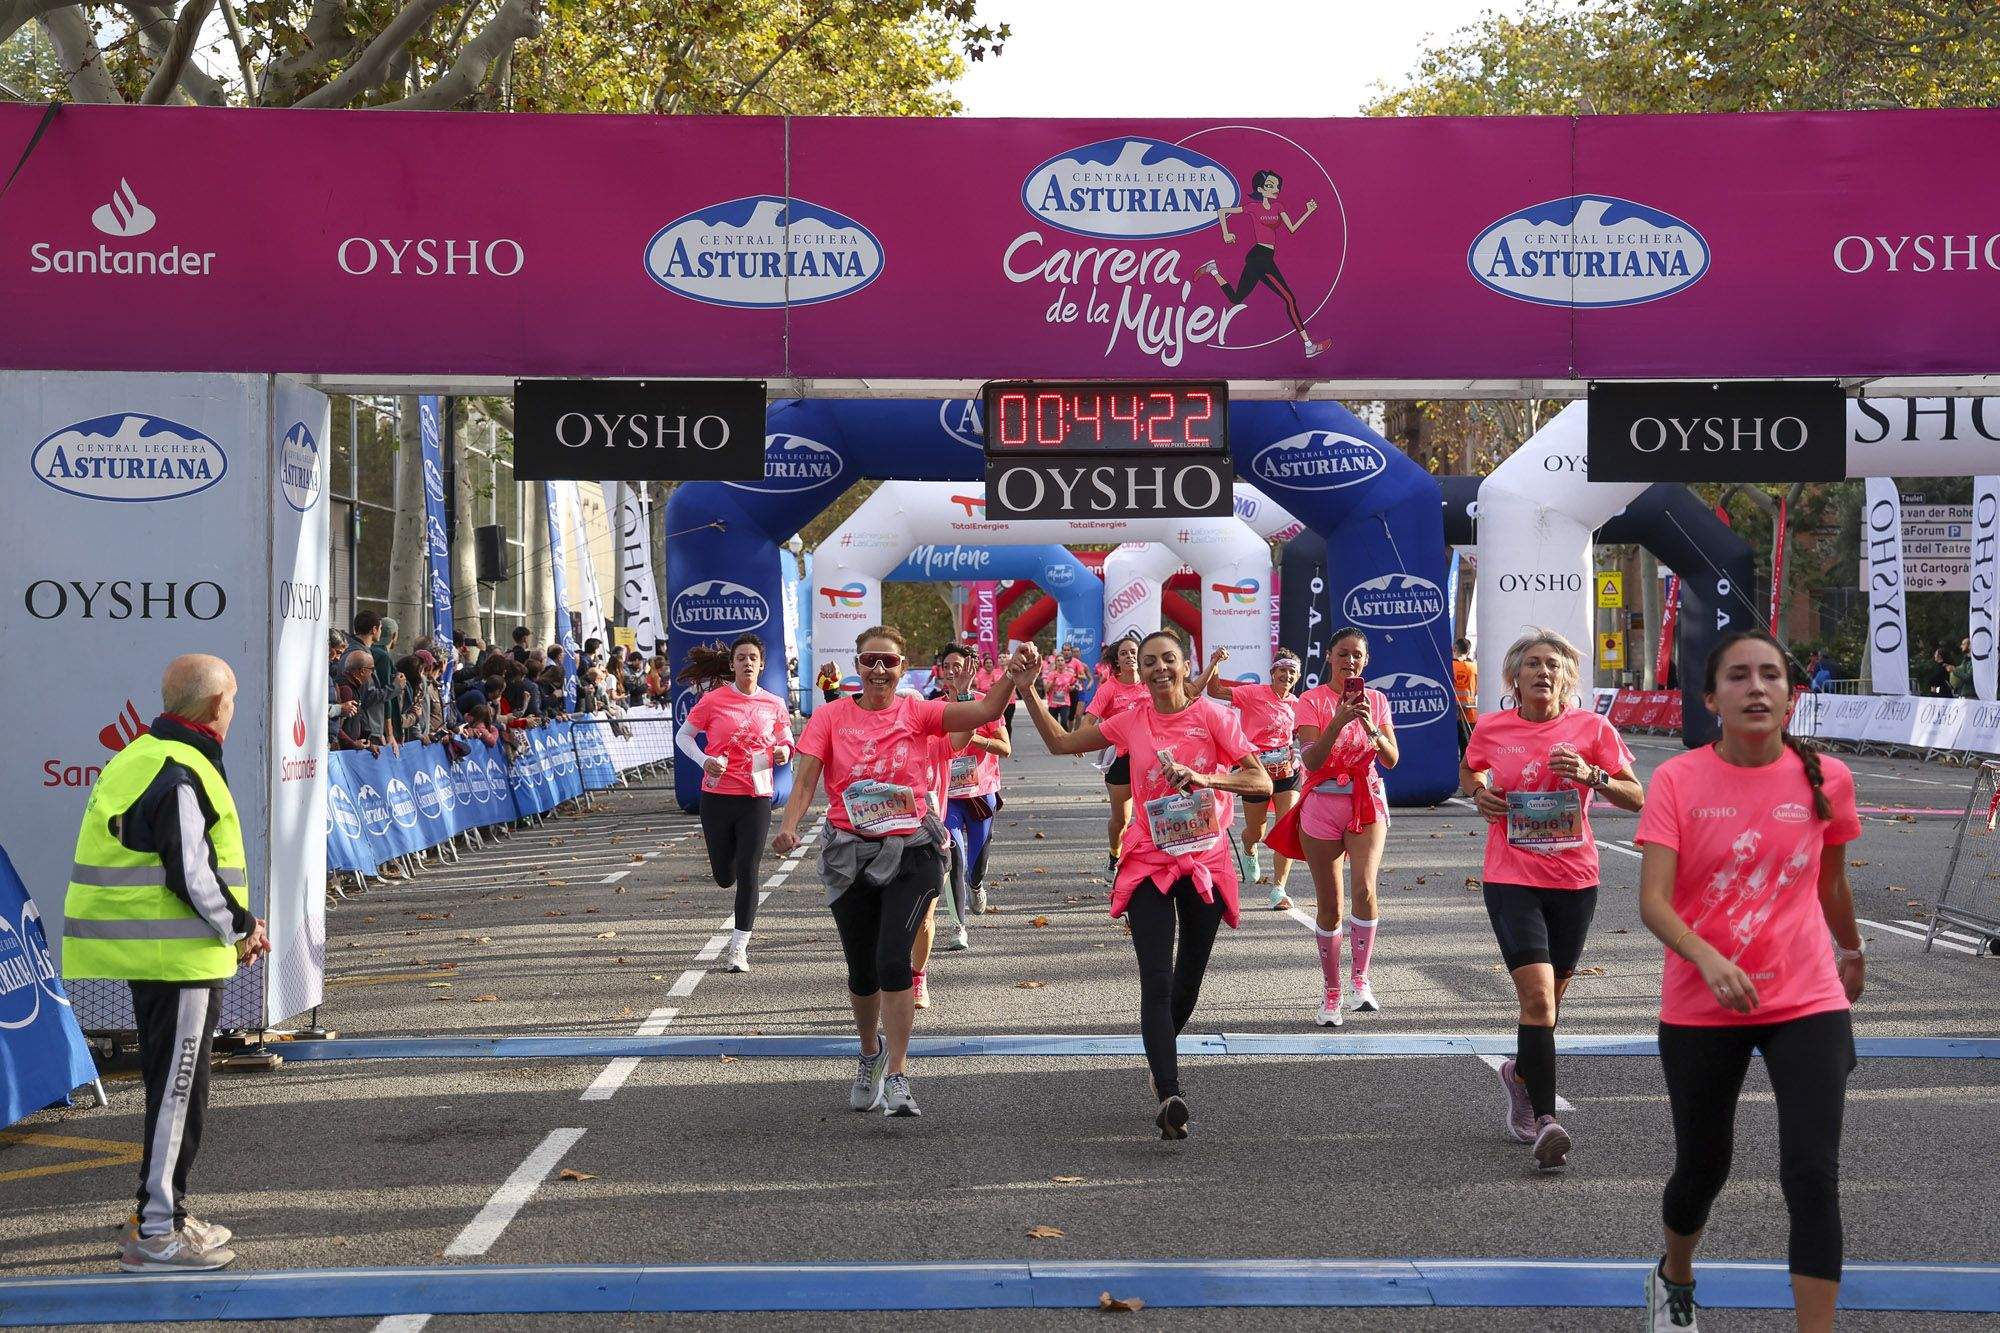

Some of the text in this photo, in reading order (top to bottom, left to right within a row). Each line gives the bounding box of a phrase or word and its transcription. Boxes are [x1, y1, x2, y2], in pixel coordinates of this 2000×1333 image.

[1072, 172, 1217, 183] CENTRAL LECHERA
[1039, 174, 1221, 213] ASTURIANA
[700, 234, 858, 245] CENTRAL LECHERA
[1525, 234, 1684, 245] CENTRAL LECHERA
[31, 242, 215, 275] Santander
[338, 238, 525, 277] OYSHO
[663, 237, 866, 279] ASTURIANA
[1003, 231, 1181, 285] Carrera
[1487, 237, 1691, 277] ASTURIANA
[1046, 286, 1110, 324] de la
[1105, 282, 1247, 367] Mujer
[555, 412, 730, 450] OYSHO
[1001, 393, 1211, 442] 00:44:22
[77, 444, 207, 454] CENTRAL LECHERA
[1630, 417, 1808, 452] OYSHO
[46, 445, 213, 479] ASTURIANA
[765, 462, 833, 478] URIANA
[1264, 456, 1379, 477] ASTURIANA
[998, 465, 1221, 512] OYSHO
[951, 523, 1009, 531] TotalEnergies
[1069, 521, 1127, 529] TotalEnergies
[1929, 508, 1945, 517] der
[909, 545, 990, 576] Marlene
[1915, 543, 1931, 553] del
[1935, 543, 1970, 553] Teatre
[1500, 573, 1582, 592] OYSHO
[1921, 563, 1971, 575] Cartogrà
[25, 580, 227, 620] OYSHO
[280, 581, 322, 622] OYSHO
[676, 603, 763, 623] ASTURIANA
[1107, 582, 1147, 619] COSMO
[1211, 608, 1261, 616] TotalEnergies
[1350, 596, 1440, 617] ASTURIANA
[820, 612, 867, 620] TotalEnergies
[1306, 577, 1323, 689] OLVO
[1391, 698, 1445, 714] URIANA
[282, 757, 318, 784] Santander
[1692, 807, 1736, 818] OYSHO
[170, 1035, 199, 1103] Joma
